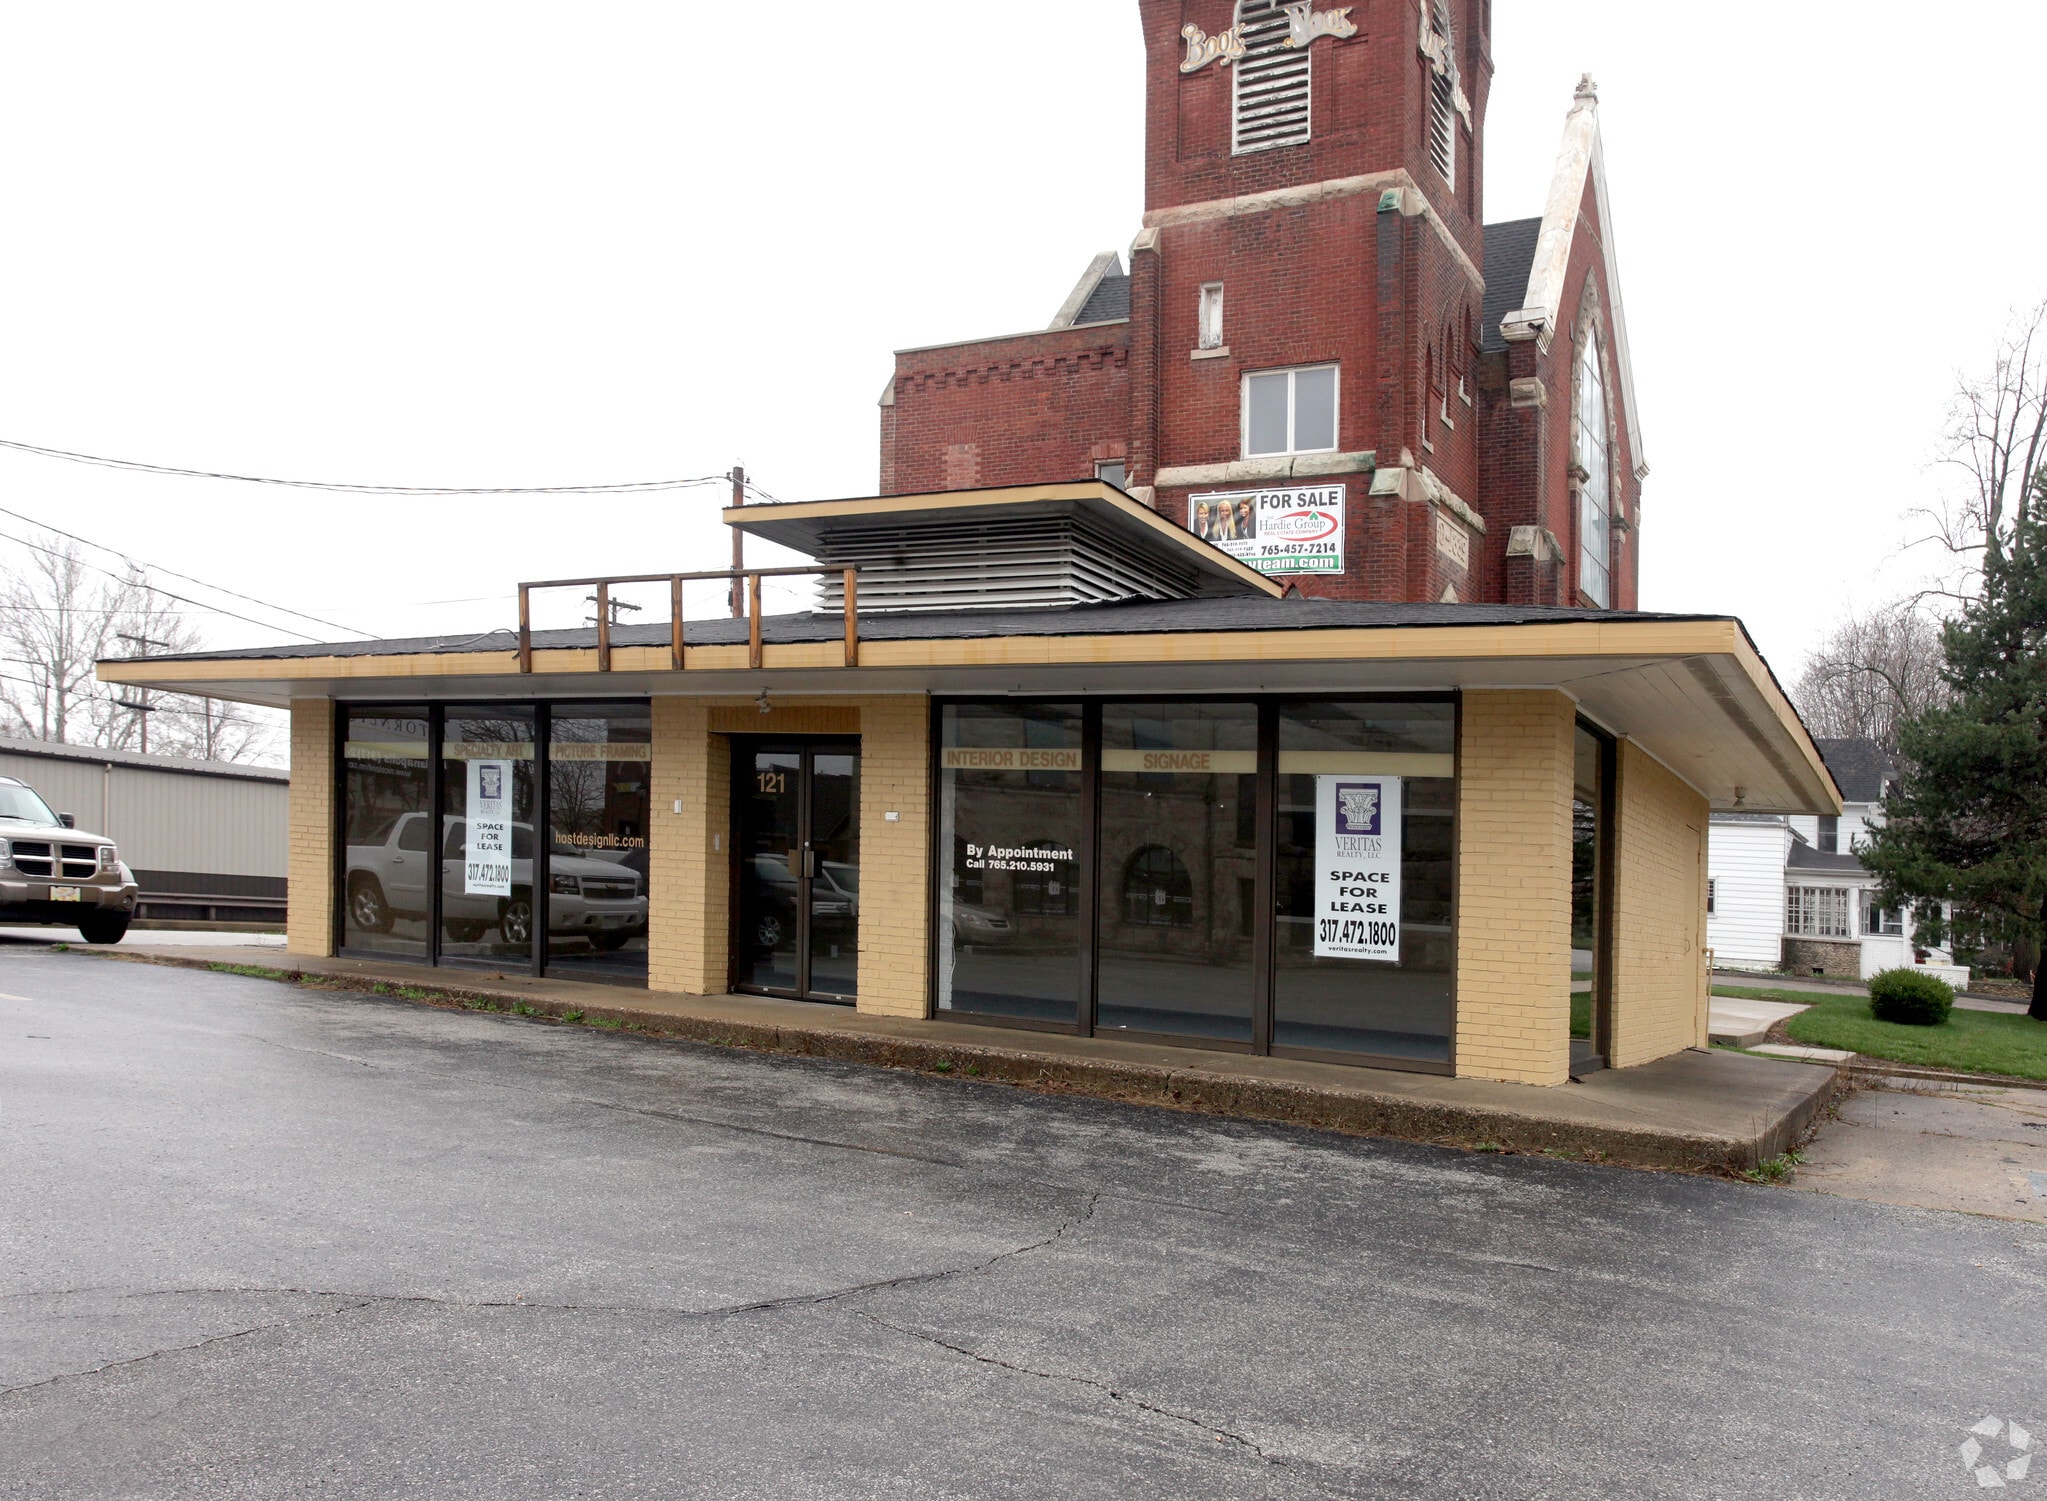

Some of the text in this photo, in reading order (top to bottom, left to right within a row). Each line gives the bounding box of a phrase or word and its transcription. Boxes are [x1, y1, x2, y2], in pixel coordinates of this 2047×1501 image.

[1260, 491, 1338, 510] FOR SALE
[1259, 517, 1326, 531] Hardie Group
[1261, 543, 1336, 556] 765-457-7214
[454, 744, 523, 755] SPECIALTY ART
[555, 743, 646, 758] PICTURE FRAMING
[947, 751, 1077, 768] INTERIOR DESIGN
[1143, 753, 1210, 770] SIGNAGE
[757, 772, 785, 793] 121
[480, 800, 502, 810] VERITAS
[477, 822, 504, 831] SPACE
[481, 833, 499, 841] FOR
[555, 832, 644, 848] hostdesignllc.com
[477, 843, 503, 851] LEASE
[1335, 836, 1382, 852] VERITAS
[966, 844, 1073, 861] By Appointment
[1336, 851, 1381, 859] REALTY, LLC
[966, 859, 1054, 872] Call 765.210.5931
[468, 862, 509, 883] 317.472.1800
[1330, 871, 1390, 883] SPACE
[1340, 887, 1378, 898] FOR
[1331, 902, 1387, 914] LEASE
[1320, 919, 1396, 947] 317.472.1800
[1328, 945, 1387, 955] veritasrealty.com
